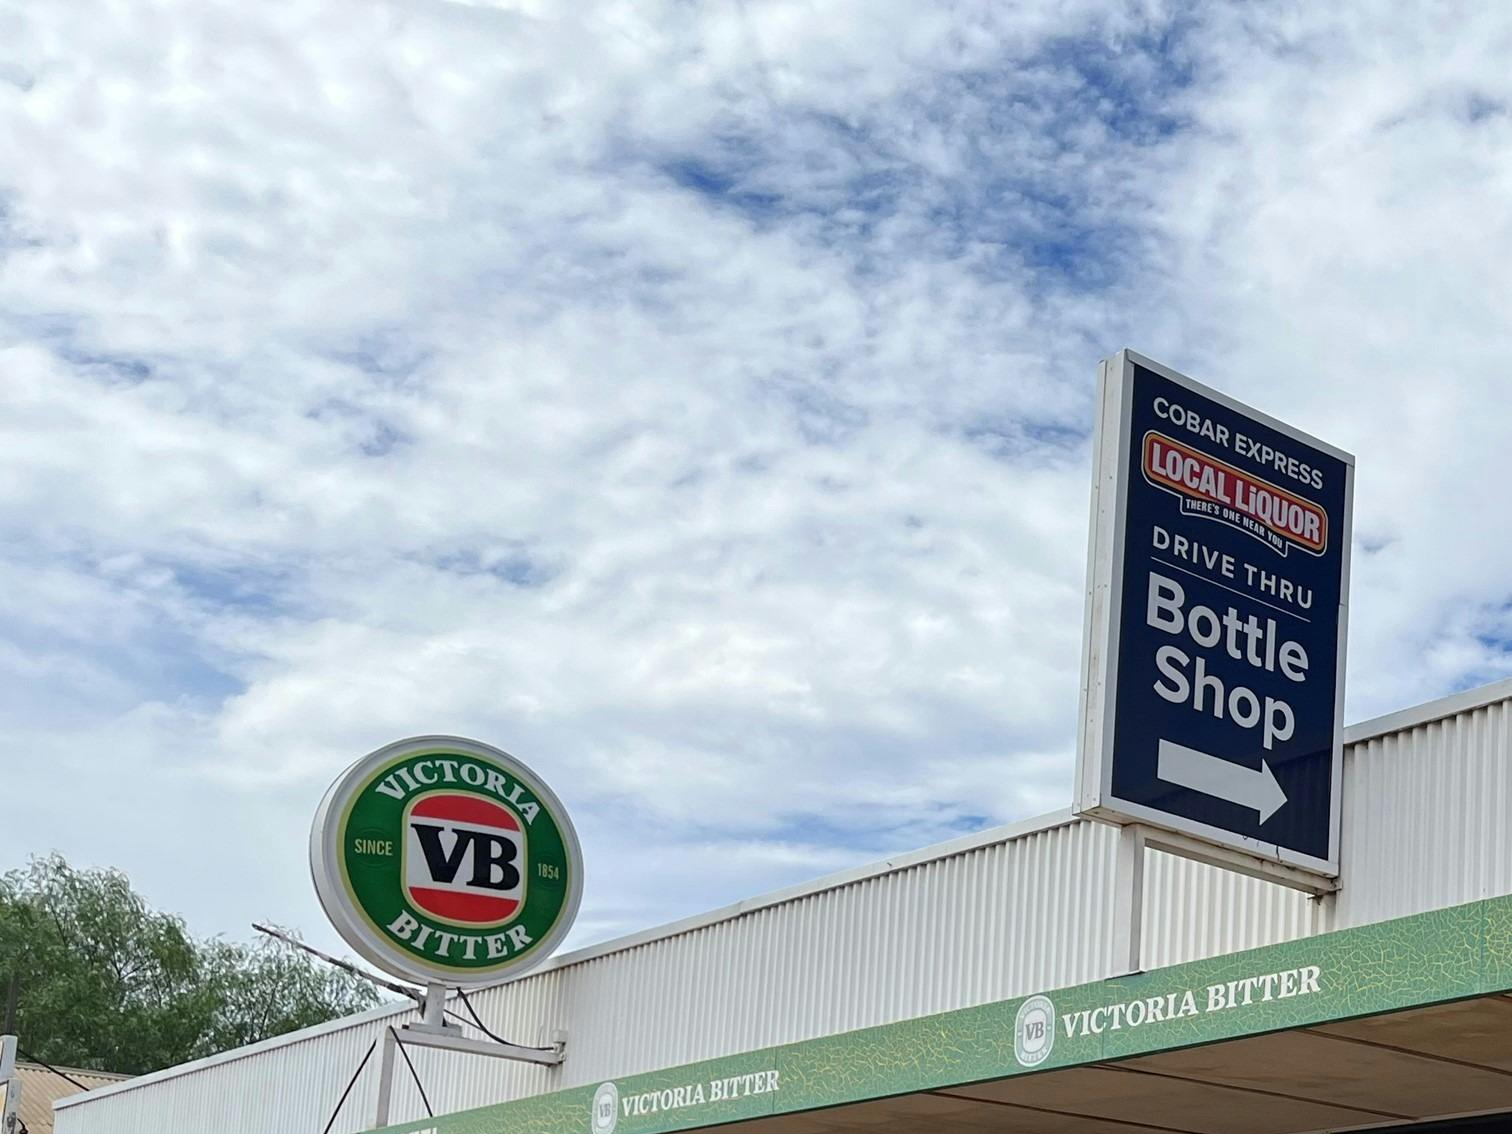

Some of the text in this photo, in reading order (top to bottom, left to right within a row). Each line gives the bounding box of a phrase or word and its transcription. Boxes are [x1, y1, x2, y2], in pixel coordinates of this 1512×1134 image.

[1152, 442, 1231, 504] LOCAL
[1153, 397, 1323, 490] COBAR EXPRESS
[1186, 499, 1283, 549] THERE'S ONE NEAR YOU
[1153, 526, 1312, 609] DRIVE THRU
[1146, 571, 1309, 682] Bottle
[1153, 645, 1295, 750] Shop
[375, 760, 542, 826] VICTORIA
[354, 838, 393, 856] SINCE
[410, 823, 520, 891] VB
[537, 862, 560, 881] 1854
[386, 909, 534, 960] BITTER
[1026, 1021, 1044, 1041] VB
[1061, 965, 1321, 1038] VICTORIA BITTER
[622, 1070, 779, 1117] VICTORIA BITTER
